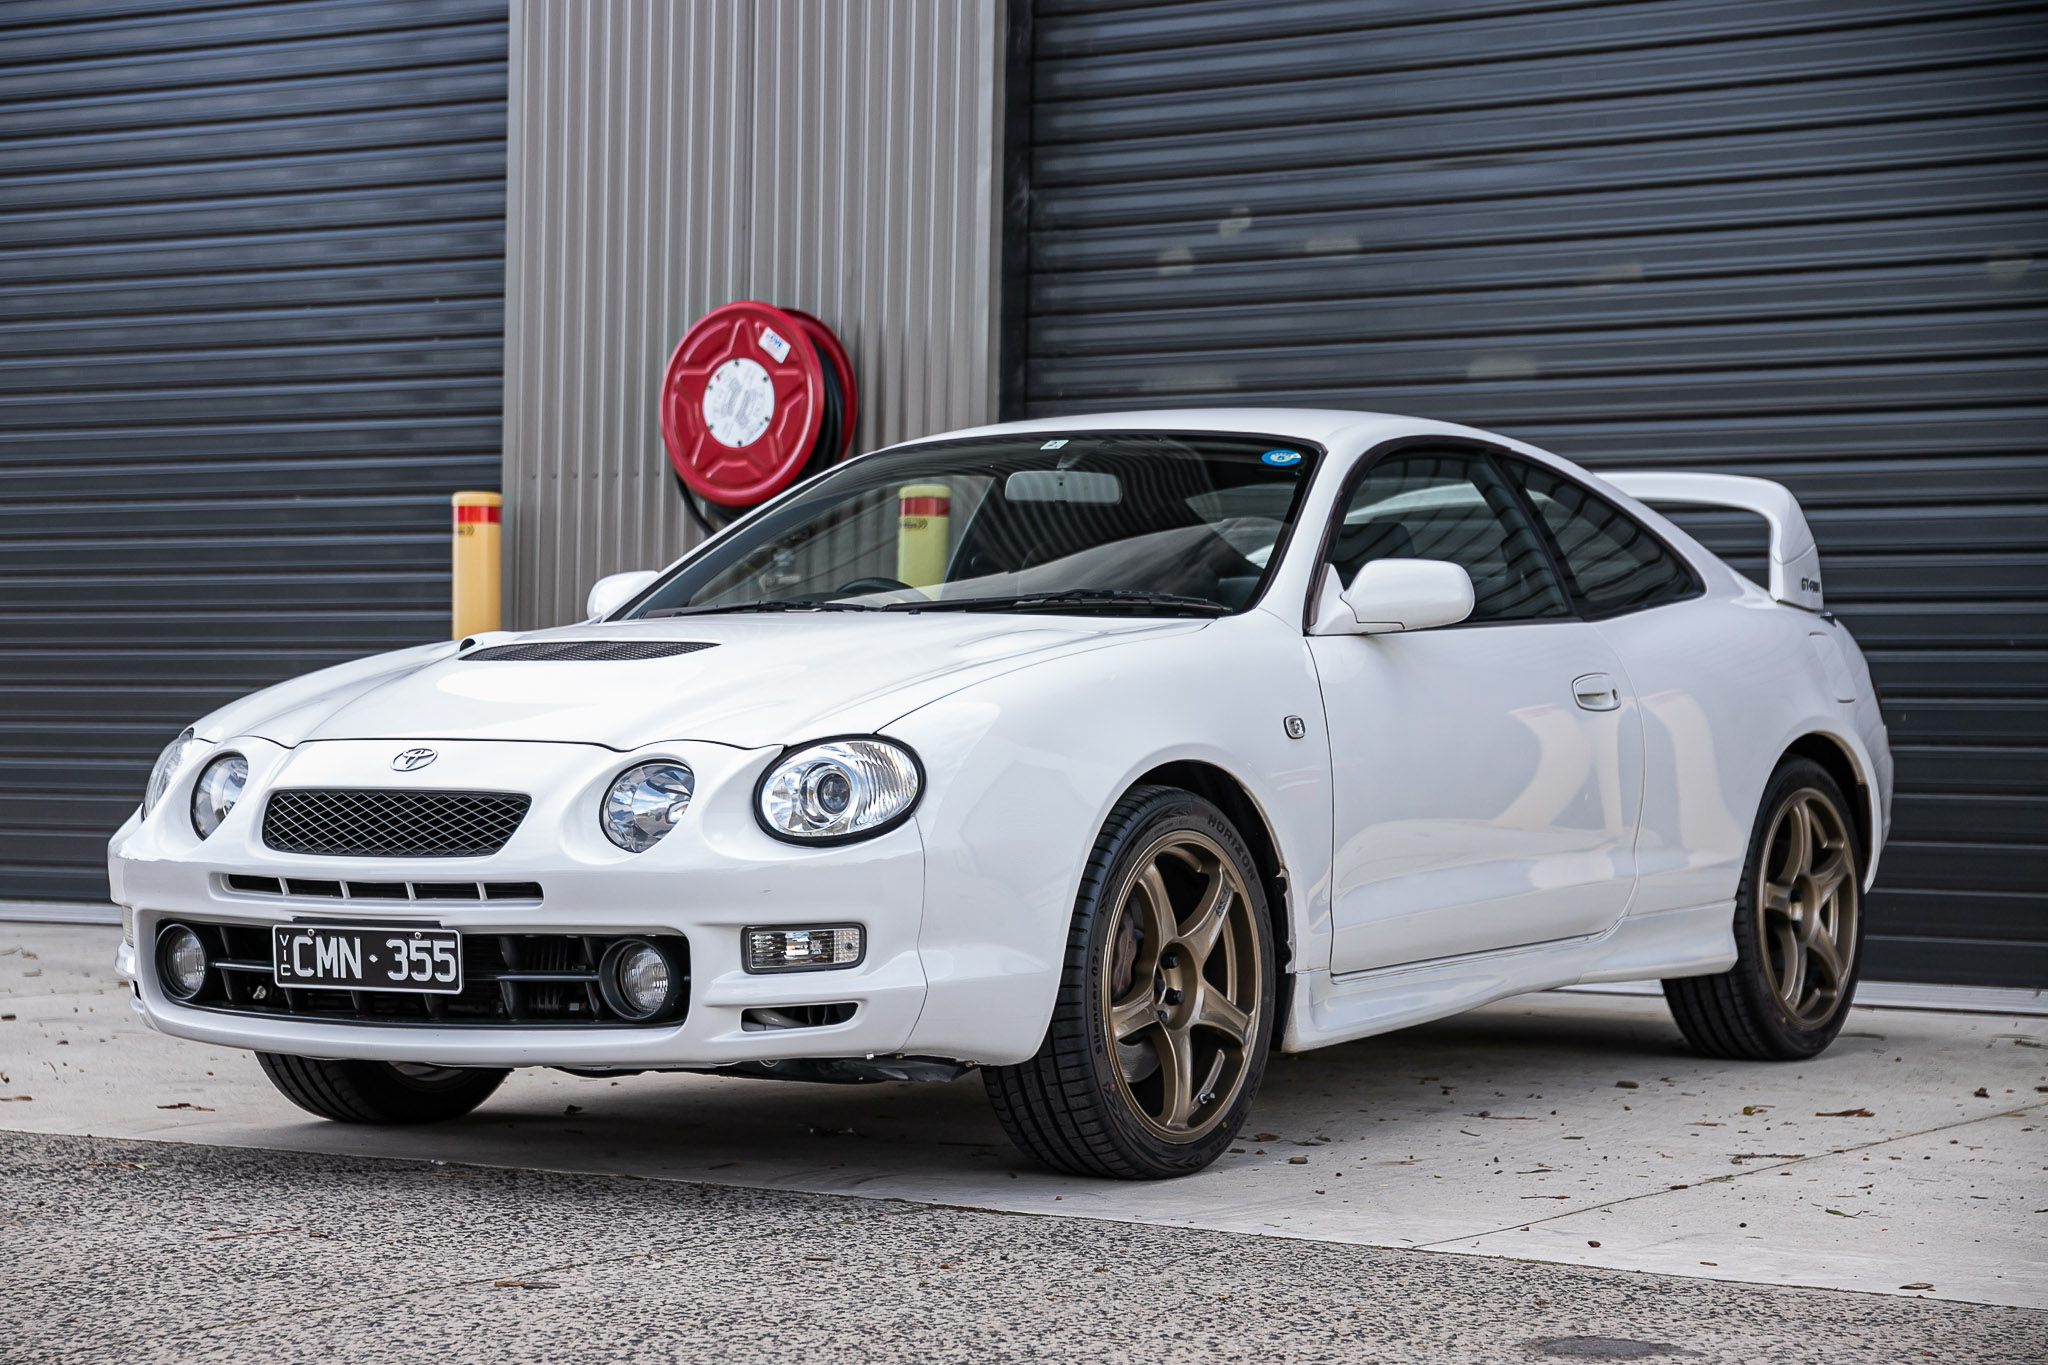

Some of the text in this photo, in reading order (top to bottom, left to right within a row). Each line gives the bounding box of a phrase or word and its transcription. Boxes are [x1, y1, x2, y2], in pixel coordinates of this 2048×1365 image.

[1207, 815, 1258, 880] HORIZON
[279, 934, 292, 977] VIC
[292, 935, 457, 983] CMN 355
[1091, 945, 1102, 1055] Silencer 02+
